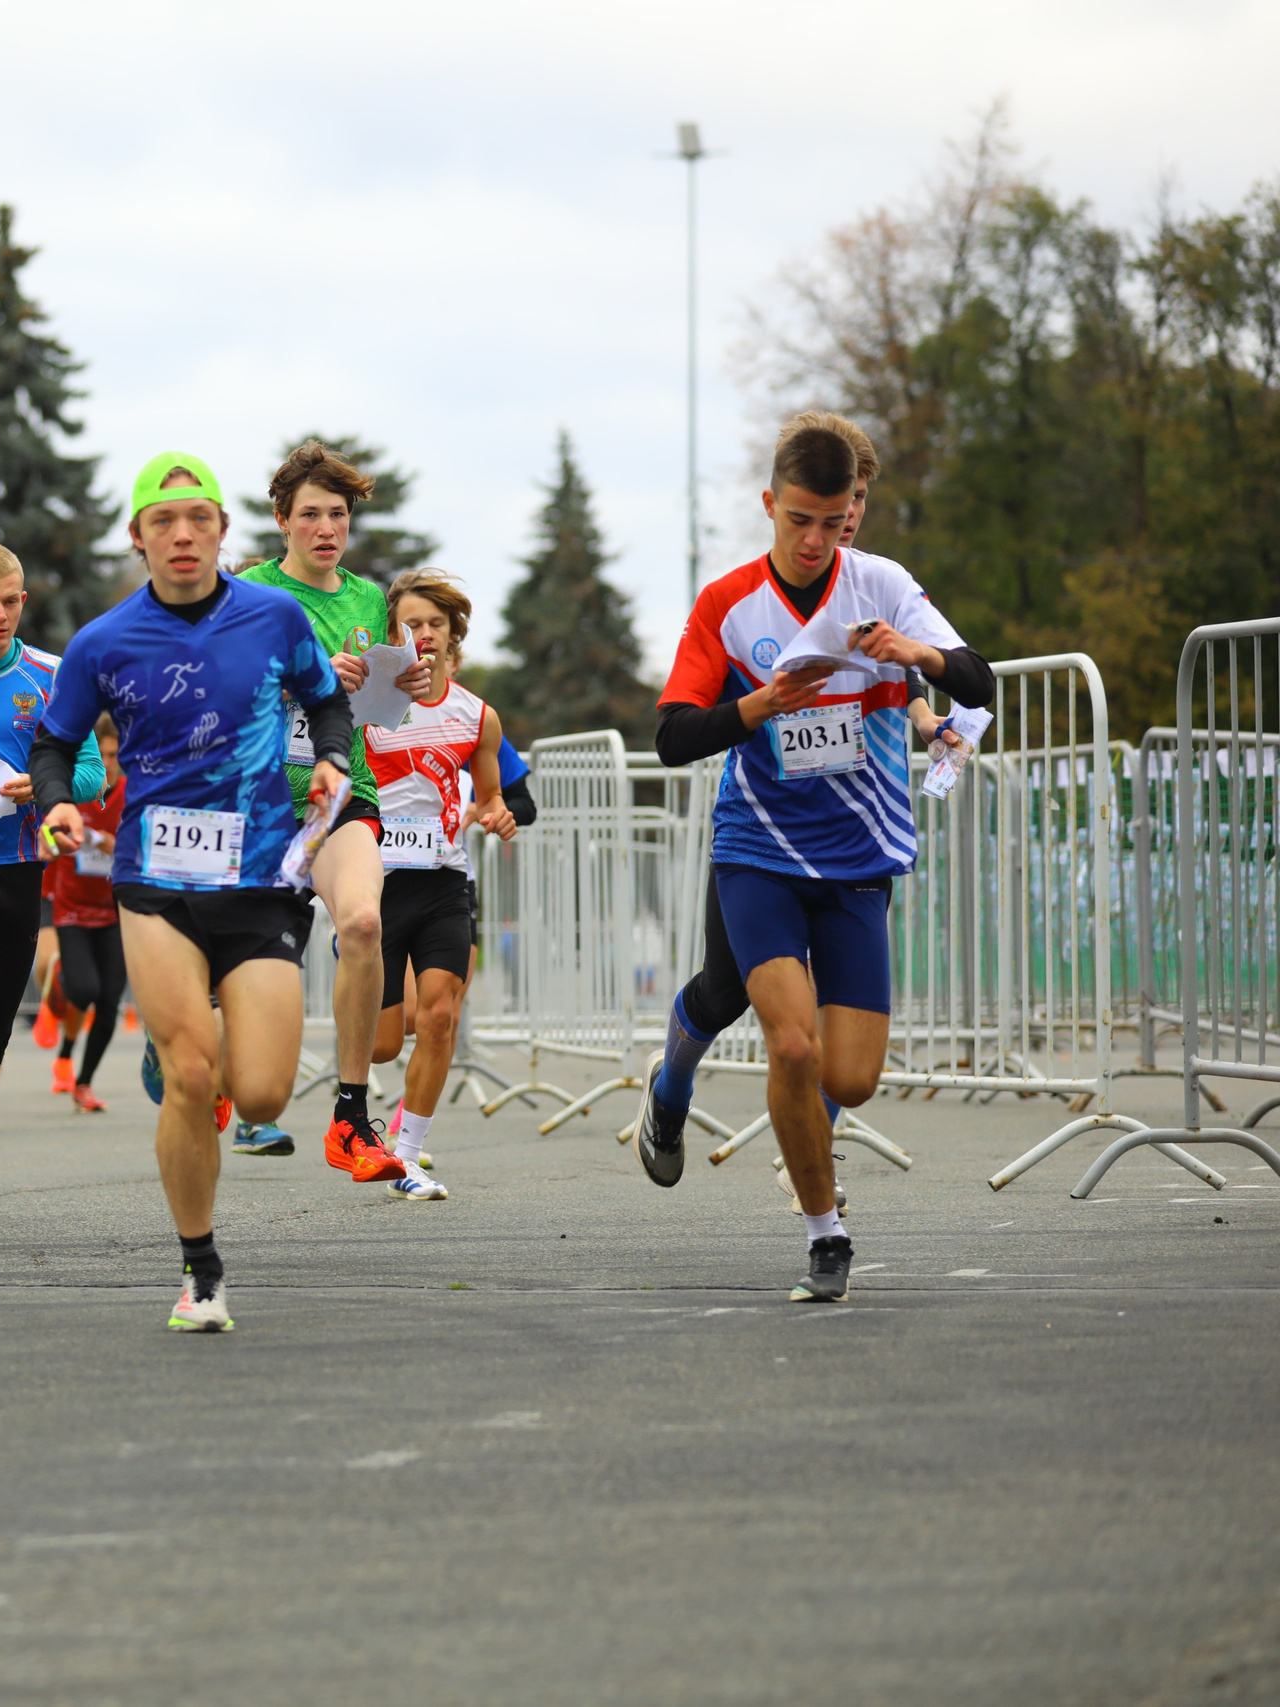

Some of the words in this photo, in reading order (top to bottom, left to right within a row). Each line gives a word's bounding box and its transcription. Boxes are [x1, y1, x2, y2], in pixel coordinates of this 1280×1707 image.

[781, 721, 851, 752] 203.1
[421, 751, 446, 778] Run
[153, 823, 223, 852] 219.1
[383, 830, 432, 849] 209.1
